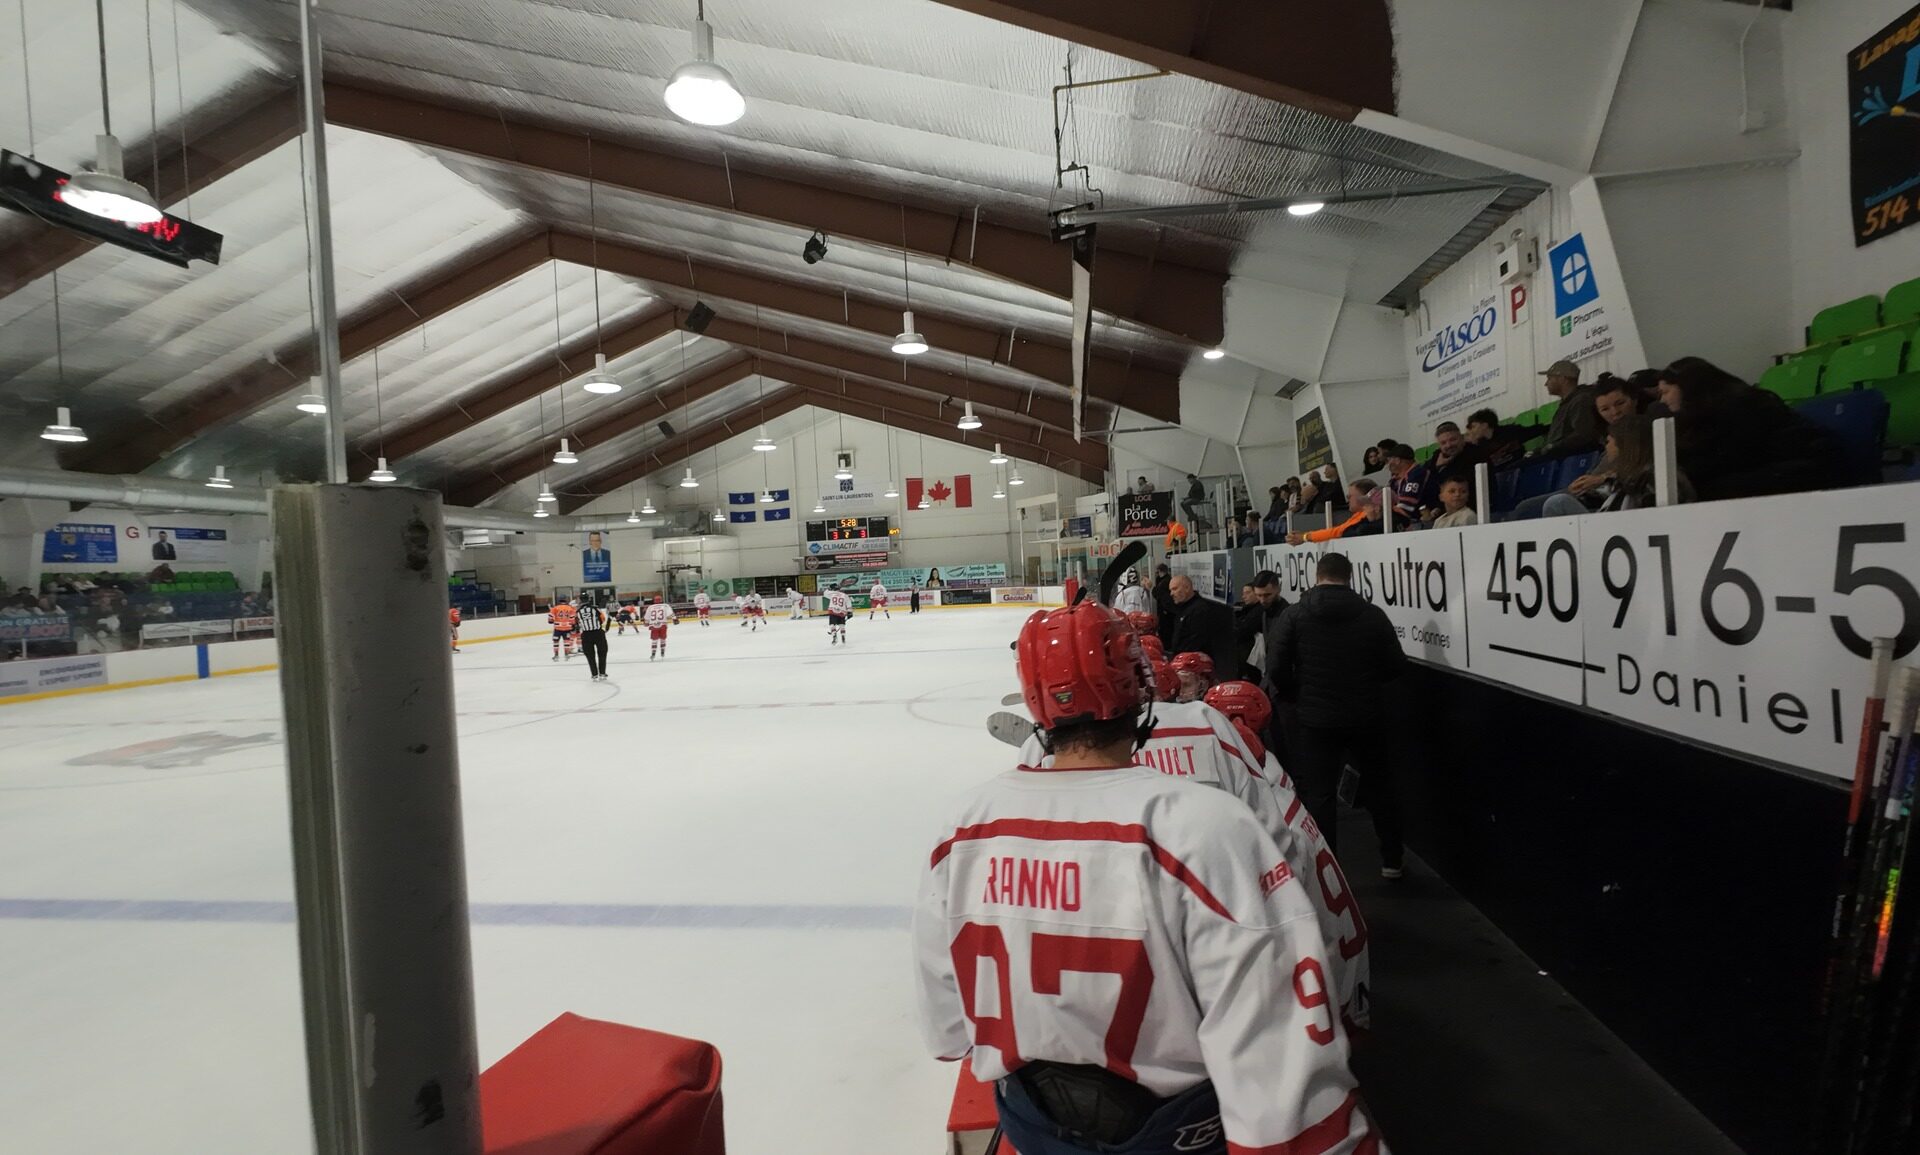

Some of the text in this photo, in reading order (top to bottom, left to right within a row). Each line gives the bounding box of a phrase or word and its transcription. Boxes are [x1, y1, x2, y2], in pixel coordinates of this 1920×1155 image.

[1861, 195, 1910, 237] 514
[1510, 284, 1526, 325] P
[1436, 306, 1497, 360] VASCO
[125, 526, 140, 539] G
[1124, 507, 1158, 521] Porte
[823, 542, 859, 551] CLIMACTIF
[1380, 547, 1448, 613] ultra
[1486, 538, 1579, 623] 450
[650, 609, 664, 621] 93
[832, 597, 844, 607] 89
[1617, 653, 1844, 744] Daniel
[949, 921, 1154, 1083] 97
